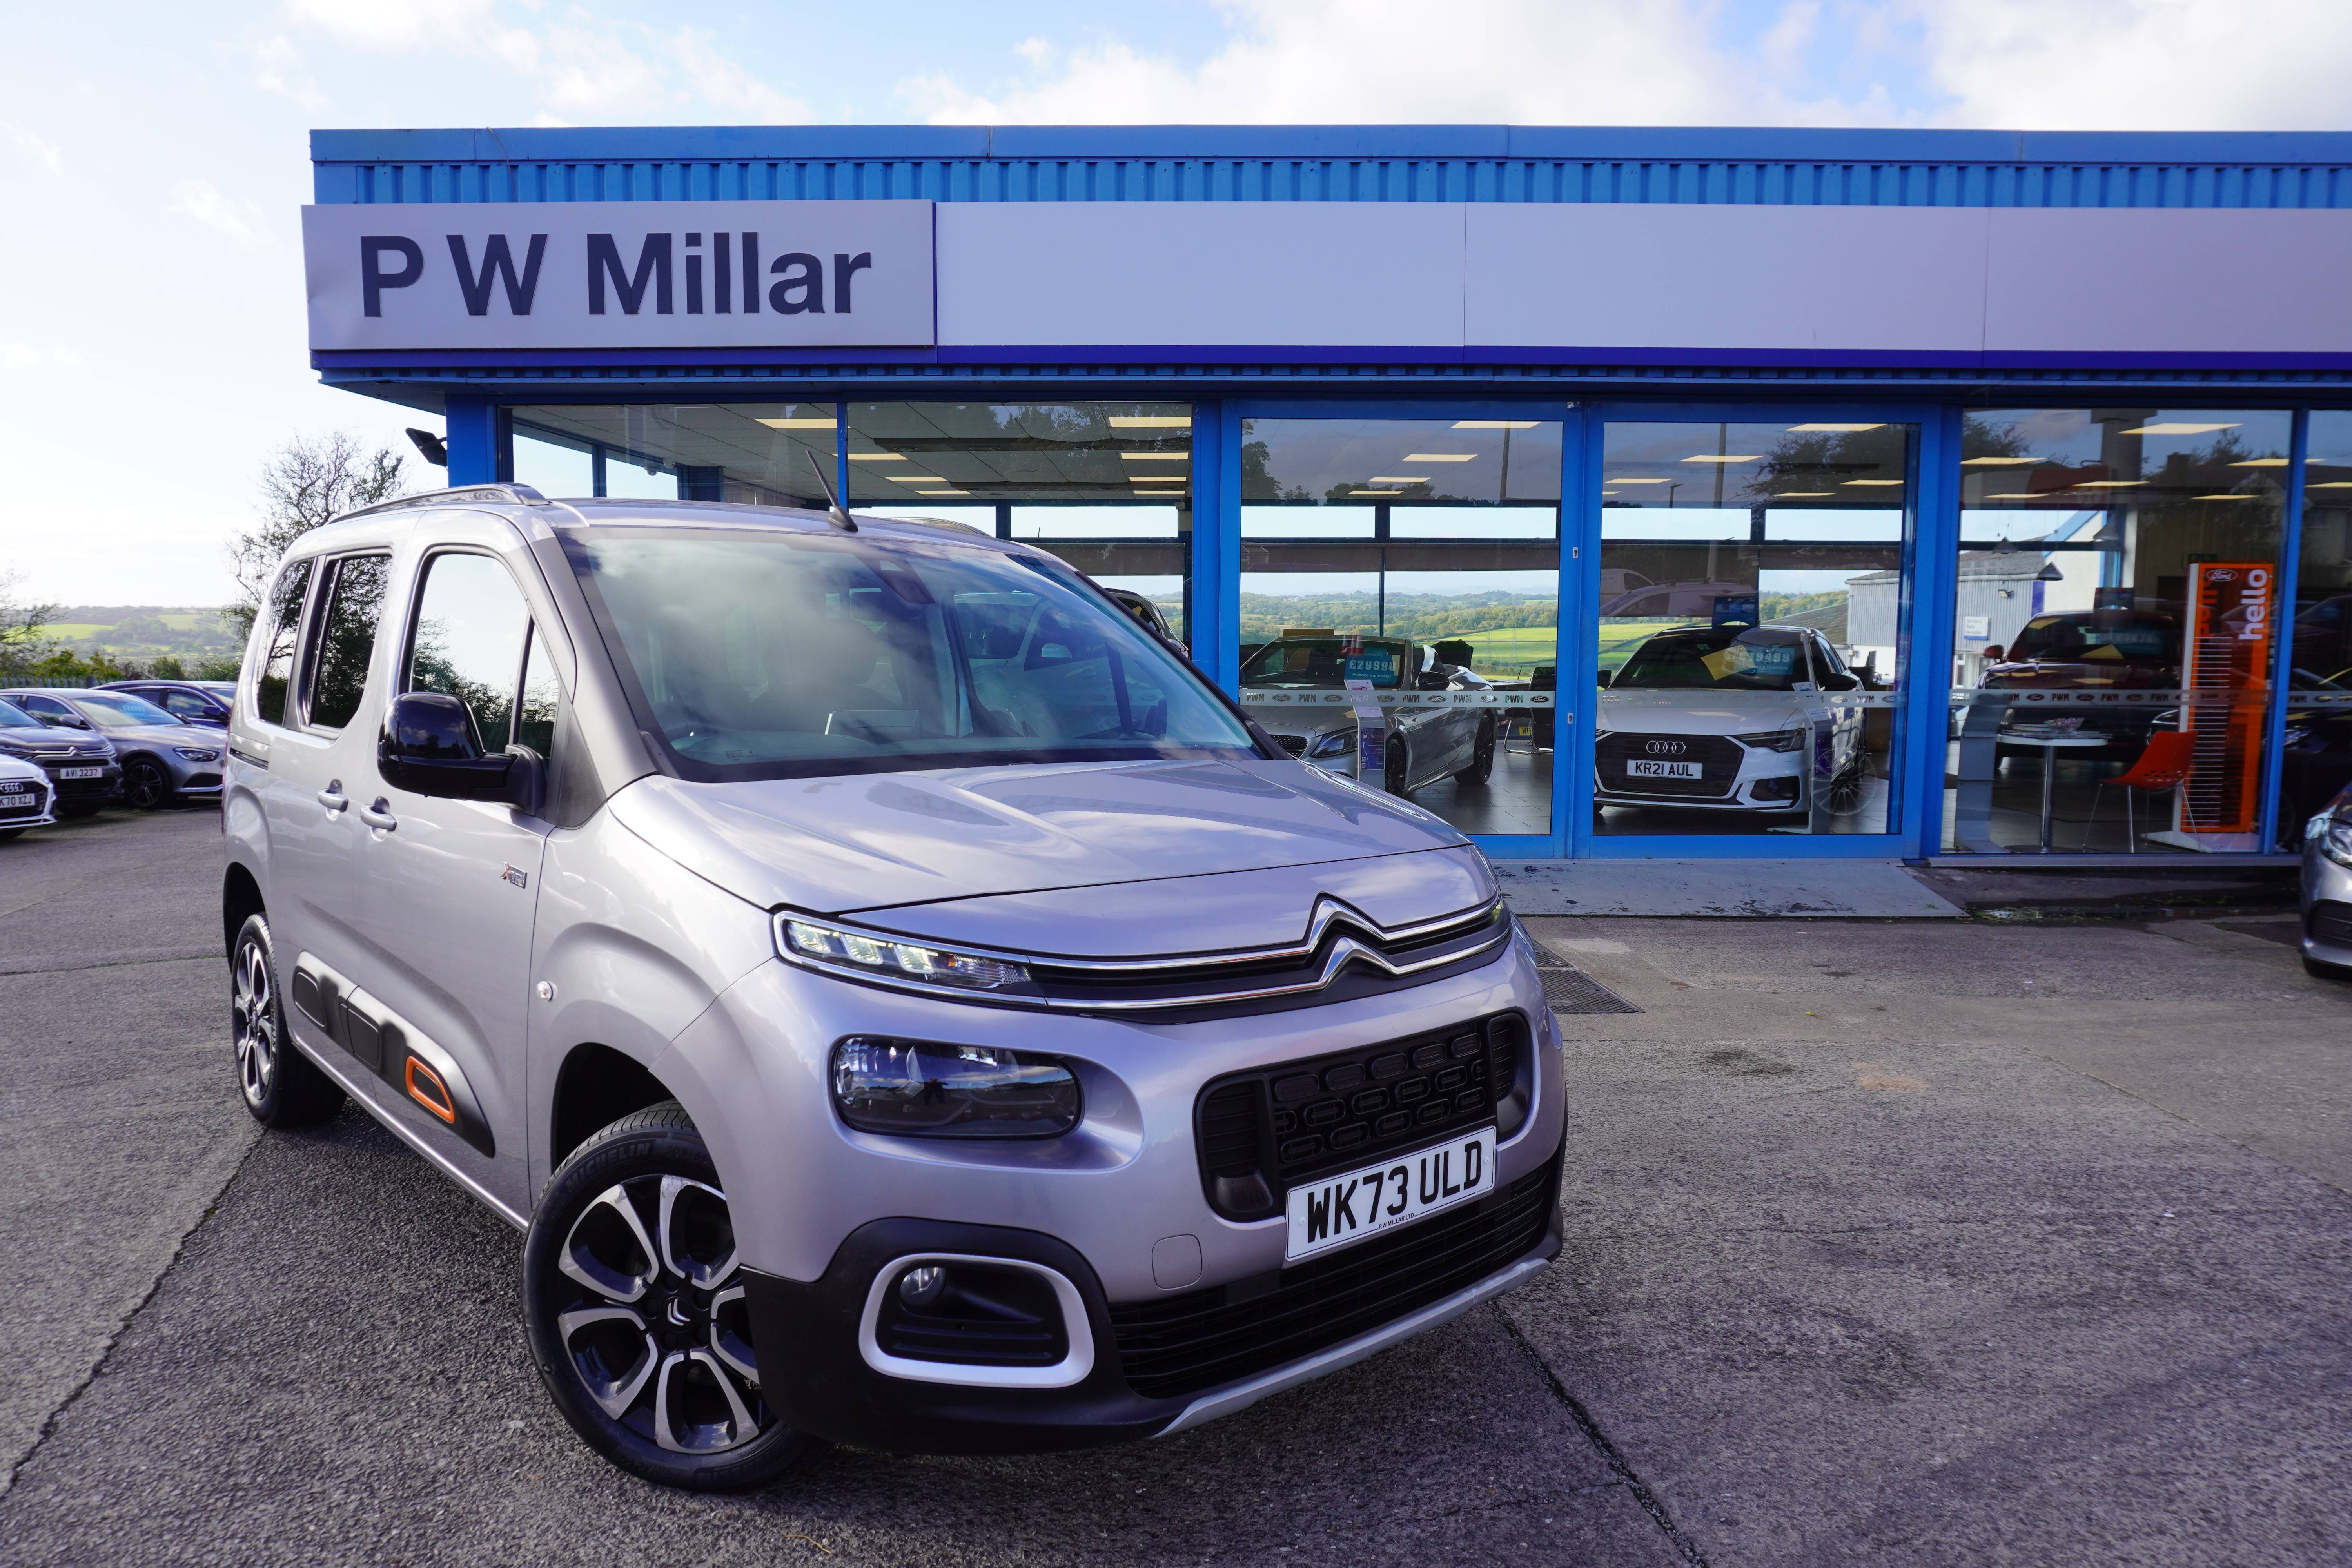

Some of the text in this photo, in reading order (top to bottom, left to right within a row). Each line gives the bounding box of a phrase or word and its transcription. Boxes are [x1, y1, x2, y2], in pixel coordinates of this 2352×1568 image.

[360, 231, 872, 317] P W Millar
[2239, 569, 2267, 640] hello
[1349, 659, 1396, 671] £29990
[1246, 693, 1265, 702] PWM
[1298, 694, 1316, 702] PWM
[1402, 695, 1420, 703] PWM
[1453, 695, 1472, 703] PWM
[1505, 695, 1523, 703] PWM
[1856, 695, 1875, 704] PWM
[1635, 762, 1694, 777] KR21 AUL
[18, 795, 32, 804] XZJ
[565, 1142, 651, 1192] MICHELIN
[1307, 1140, 1482, 1244] WK73 ULD
[1378, 1216, 1405, 1230] P.W.MILLAR
